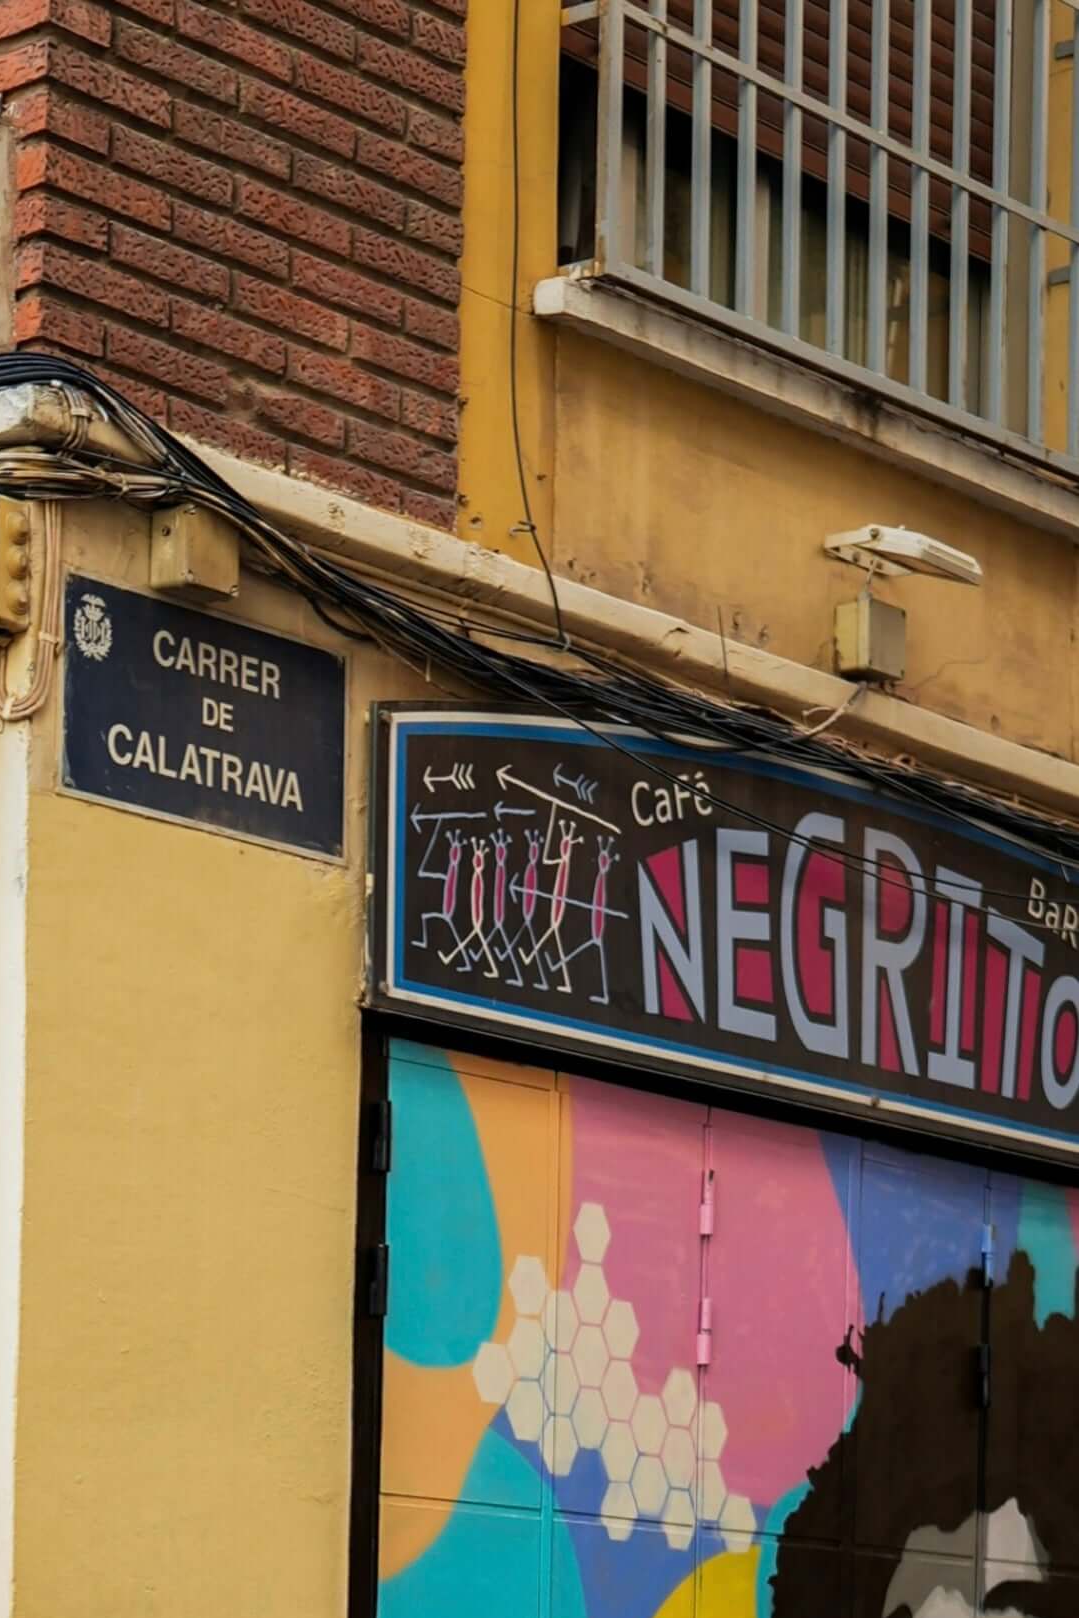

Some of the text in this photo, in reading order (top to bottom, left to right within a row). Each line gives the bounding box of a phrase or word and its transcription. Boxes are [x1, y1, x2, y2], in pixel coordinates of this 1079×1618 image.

[153, 630, 280, 699] CARRER
[202, 697, 234, 732] DE
[107, 724, 303, 812] CALATRAVA
[637, 812, 1079, 1111] NEGRITO
